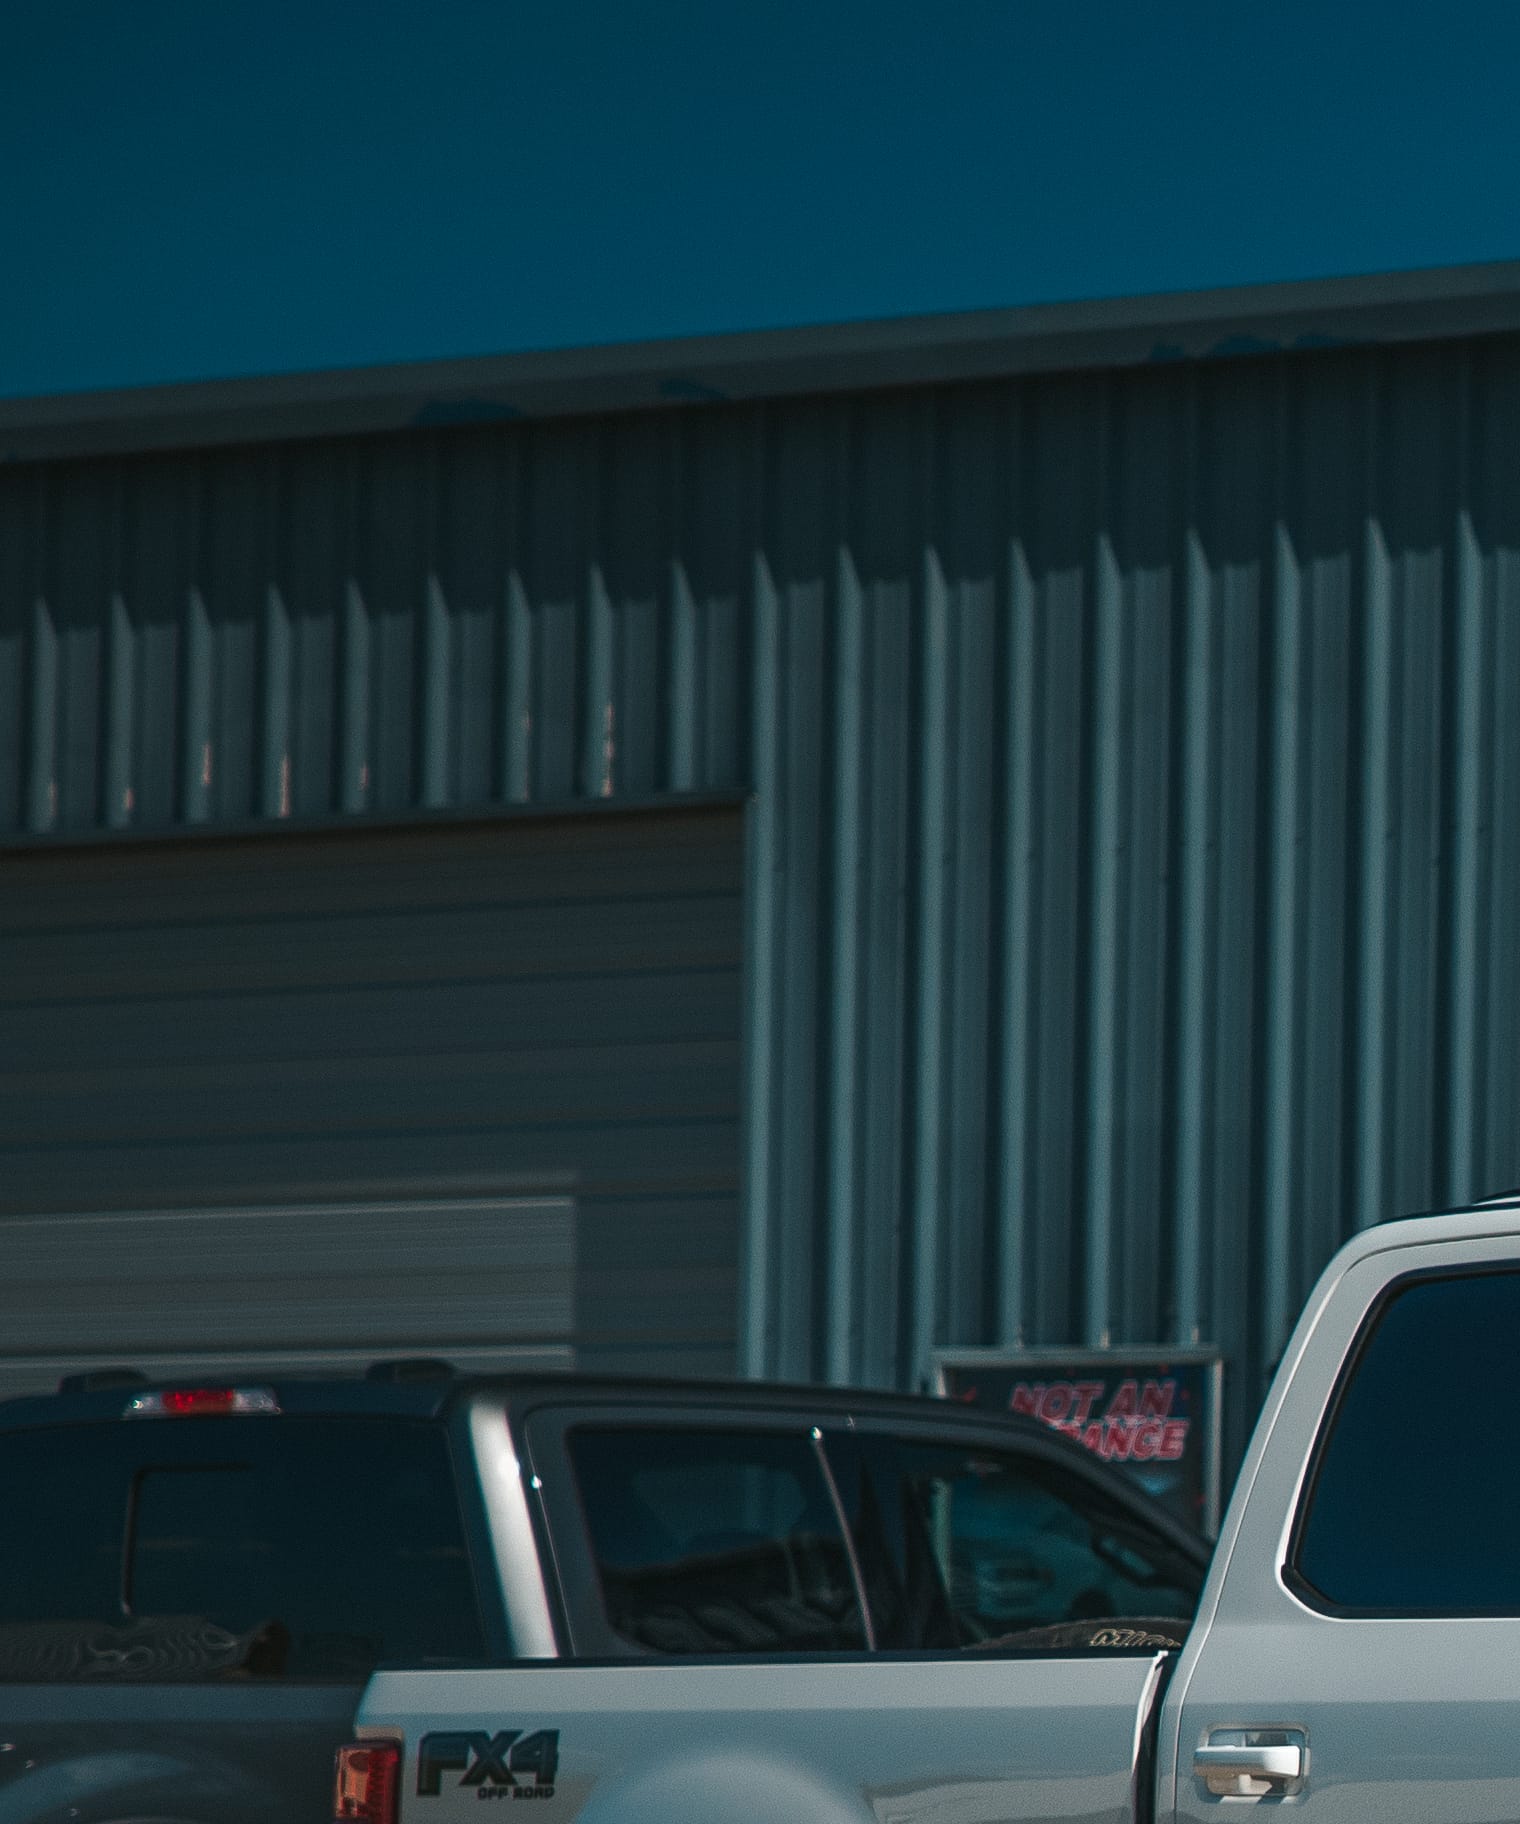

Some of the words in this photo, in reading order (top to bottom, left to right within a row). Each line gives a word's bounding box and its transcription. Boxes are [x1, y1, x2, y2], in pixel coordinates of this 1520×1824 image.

[1009, 1380, 1105, 1426] NOT
[1104, 1377, 1177, 1422] AN
[415, 1728, 561, 1797] FX4
[477, 1786, 508, 1801] OFF
[512, 1785, 556, 1800] ROAD
